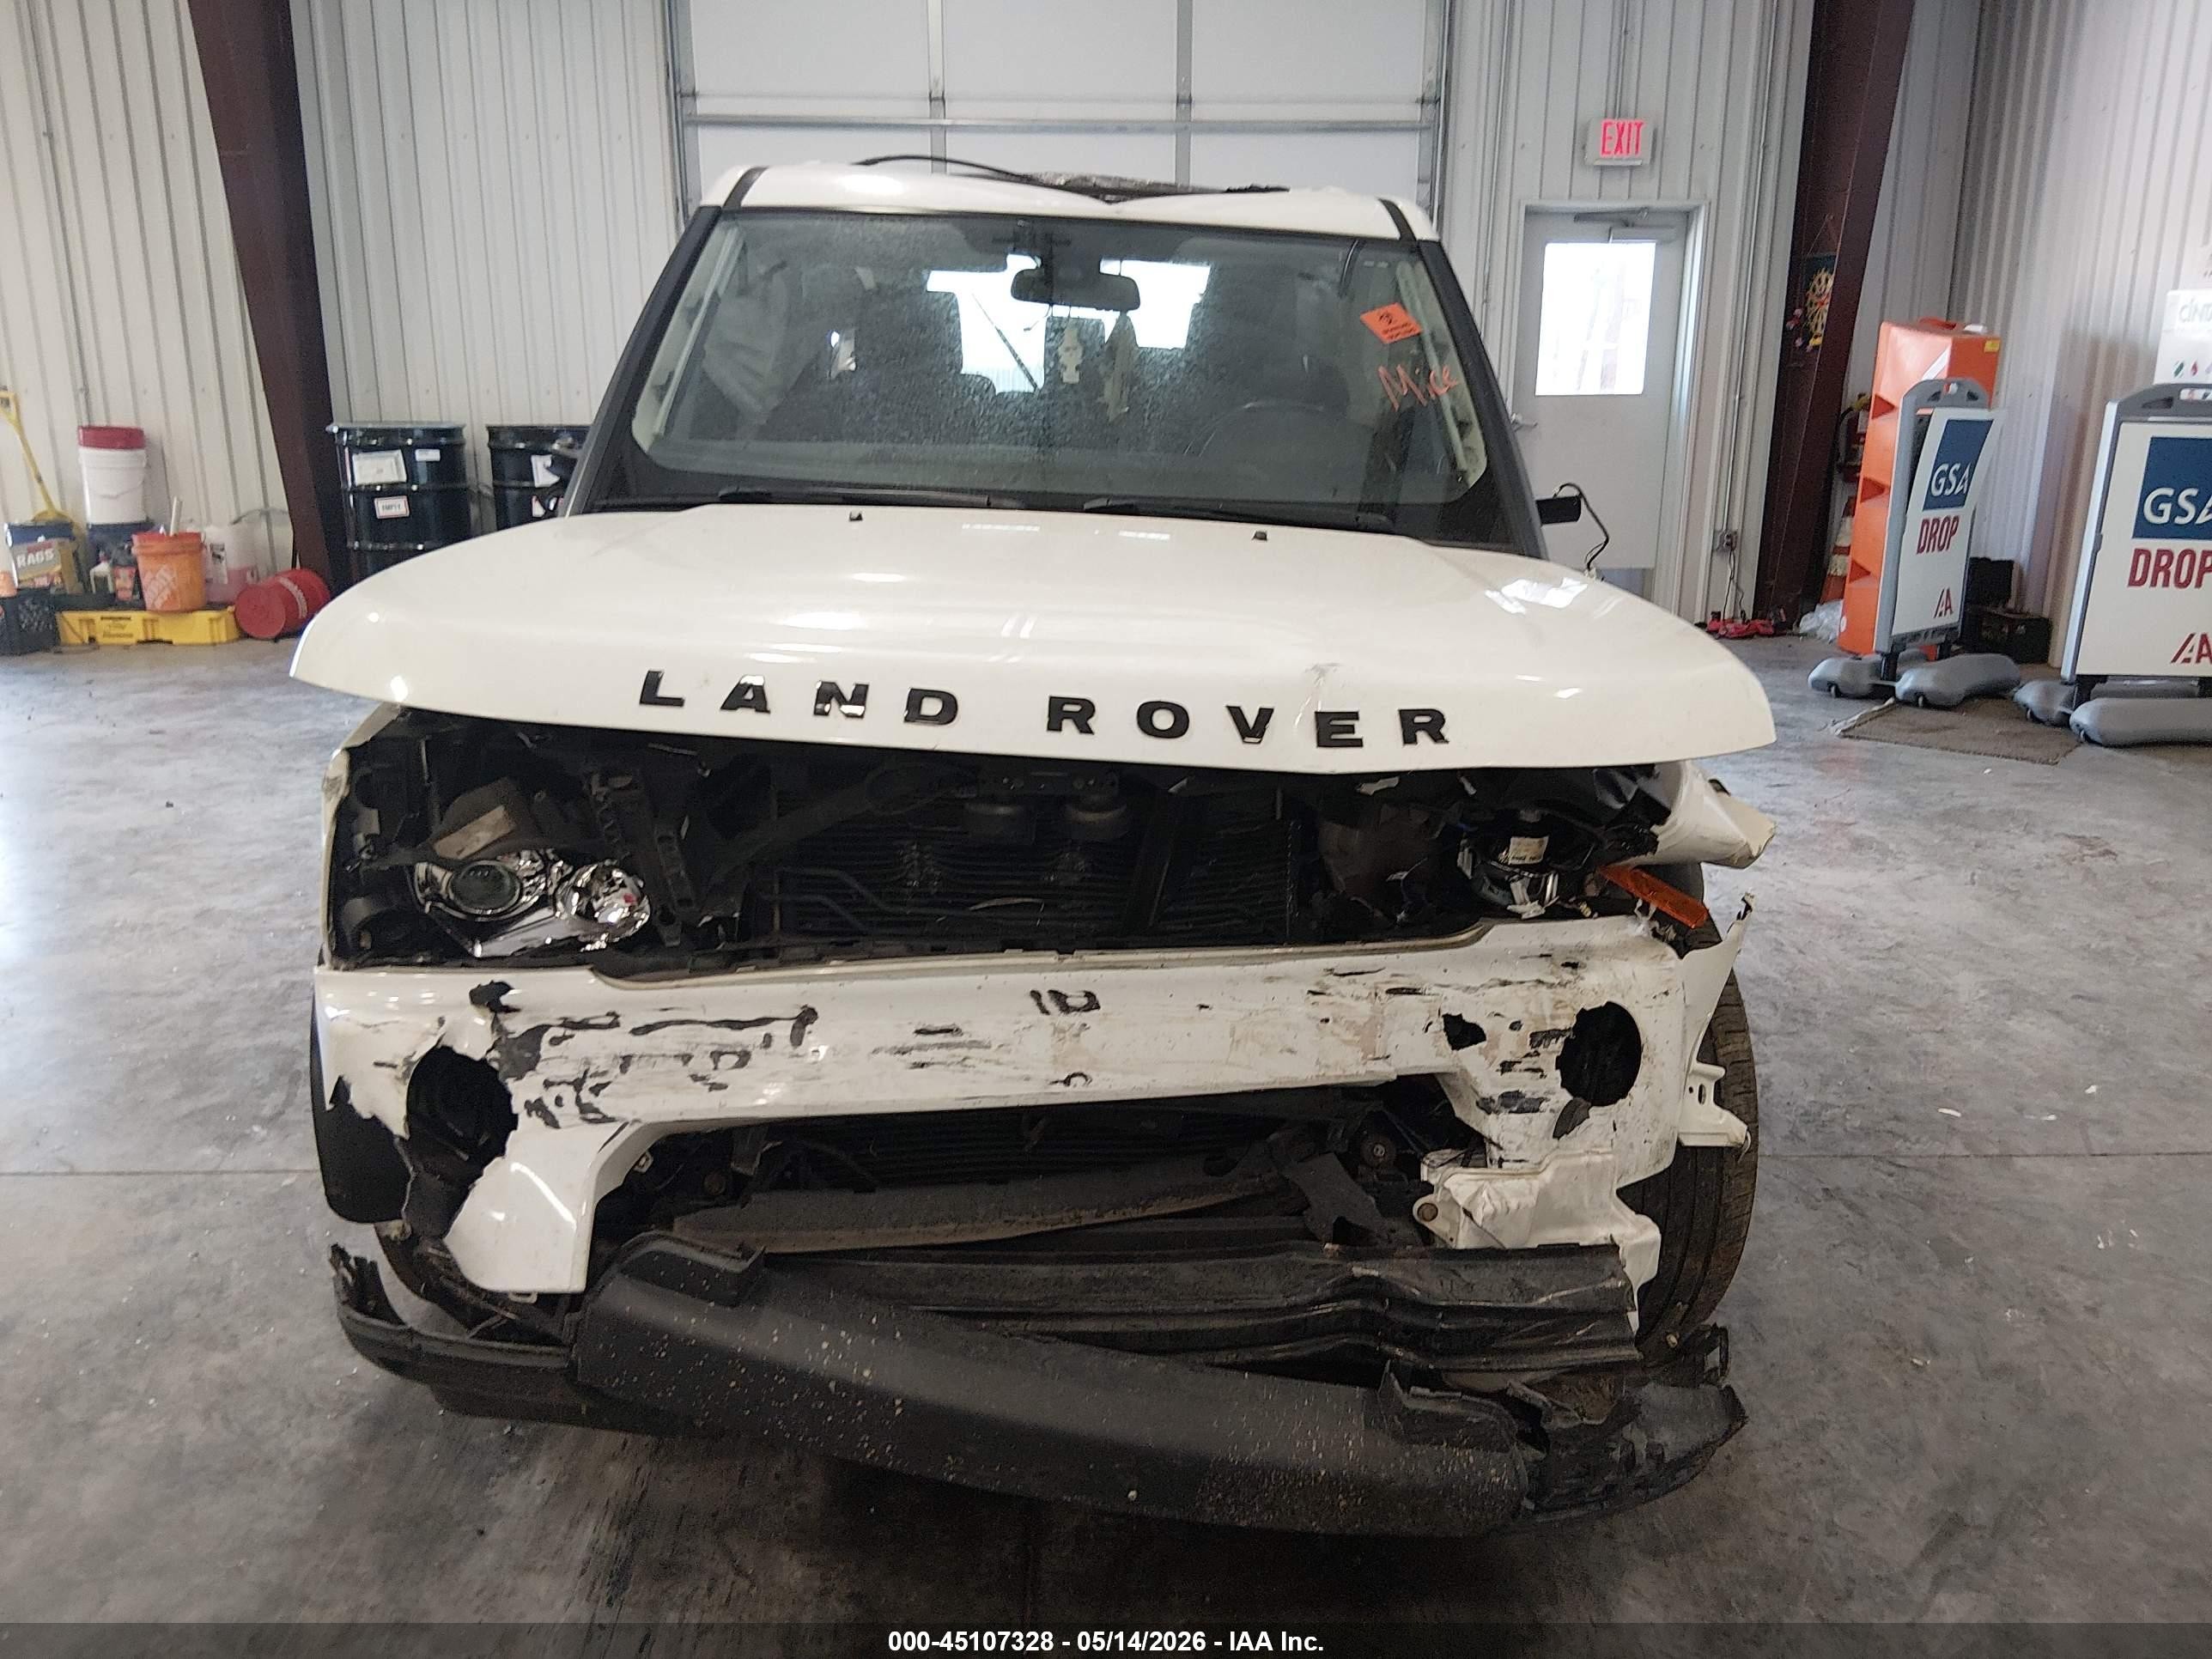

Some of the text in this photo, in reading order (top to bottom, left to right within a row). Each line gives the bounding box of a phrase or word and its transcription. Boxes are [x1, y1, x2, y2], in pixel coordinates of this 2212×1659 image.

[1601, 120, 1644, 155] EXIT
[1930, 462, 1973, 497] GSA
[1917, 515, 1960, 556] DROP
[2127, 548, 2212, 590] DROP
[639, 670, 1449, 748] LAND ROVER
